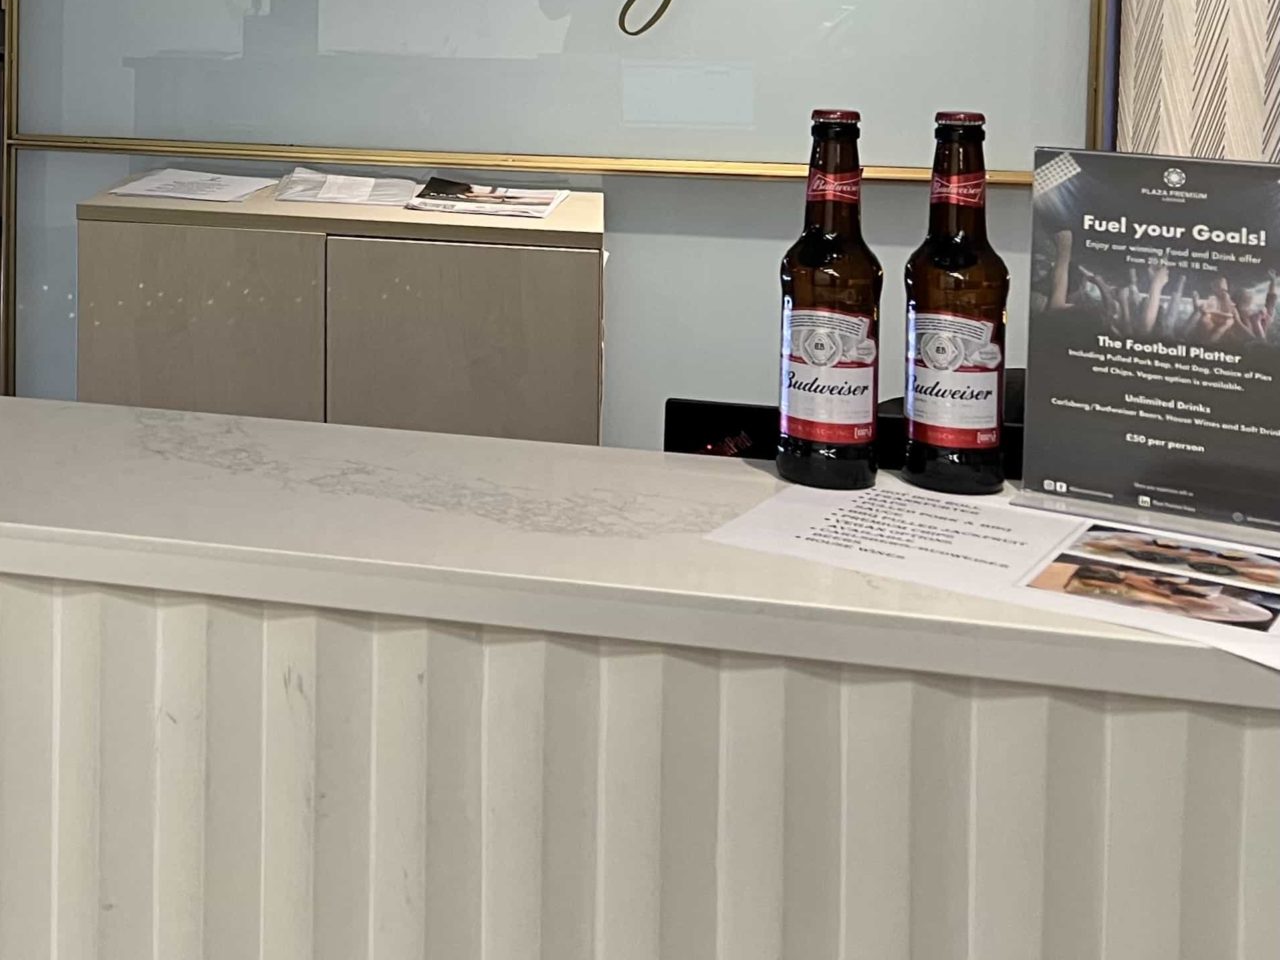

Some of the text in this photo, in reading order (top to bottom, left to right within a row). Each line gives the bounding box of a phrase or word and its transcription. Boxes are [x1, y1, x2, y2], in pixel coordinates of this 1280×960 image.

[1169, 190, 1208, 199] PREMIUM
[1083, 215, 1266, 246] Fuel your Goals!
[1086, 240, 1109, 251] Enjoy
[1129, 246, 1164, 256] winning
[1166, 247, 1189, 257] Food
[1191, 250, 1209, 259] and
[1212, 251, 1235, 262] Drink
[1238, 254, 1262, 264] offer
[1126, 255, 1145, 264] From
[1202, 262, 1218, 271] Dec
[1097, 335, 1241, 363] The Football Platter
[1068, 348, 1105, 361] Including
[1106, 354, 1132, 363] Pulled
[1133, 357, 1152, 365] Pork
[1174, 362, 1190, 370] Hot
[1213, 367, 1242, 377] Choice
[1255, 372, 1272, 381] Pies
[787, 371, 869, 396] Budweiser
[1136, 371, 1163, 380] Vegan
[1165, 376, 1191, 384] option
[1202, 380, 1245, 391] available.
[1125, 394, 1211, 413] Unlimited Drinks
[1165, 414, 1192, 424] House
[1194, 418, 1220, 428] Wines
[1240, 424, 1258, 433] Soft
[1126, 433, 1205, 452] £50 per person
[855, 505, 903, 516] SAUCE
[861, 501, 916, 514] PULLED
[919, 512, 958, 522] PORK
[835, 518, 953, 544] VEGAN OPTIONS
[841, 514, 907, 530] PREMIUM
[881, 515, 937, 530] PULLED
[941, 528, 1028, 546] JACKFRUIT
[827, 524, 915, 543] AVAILABLE
[805, 537, 905, 559] HOUSE WINES
